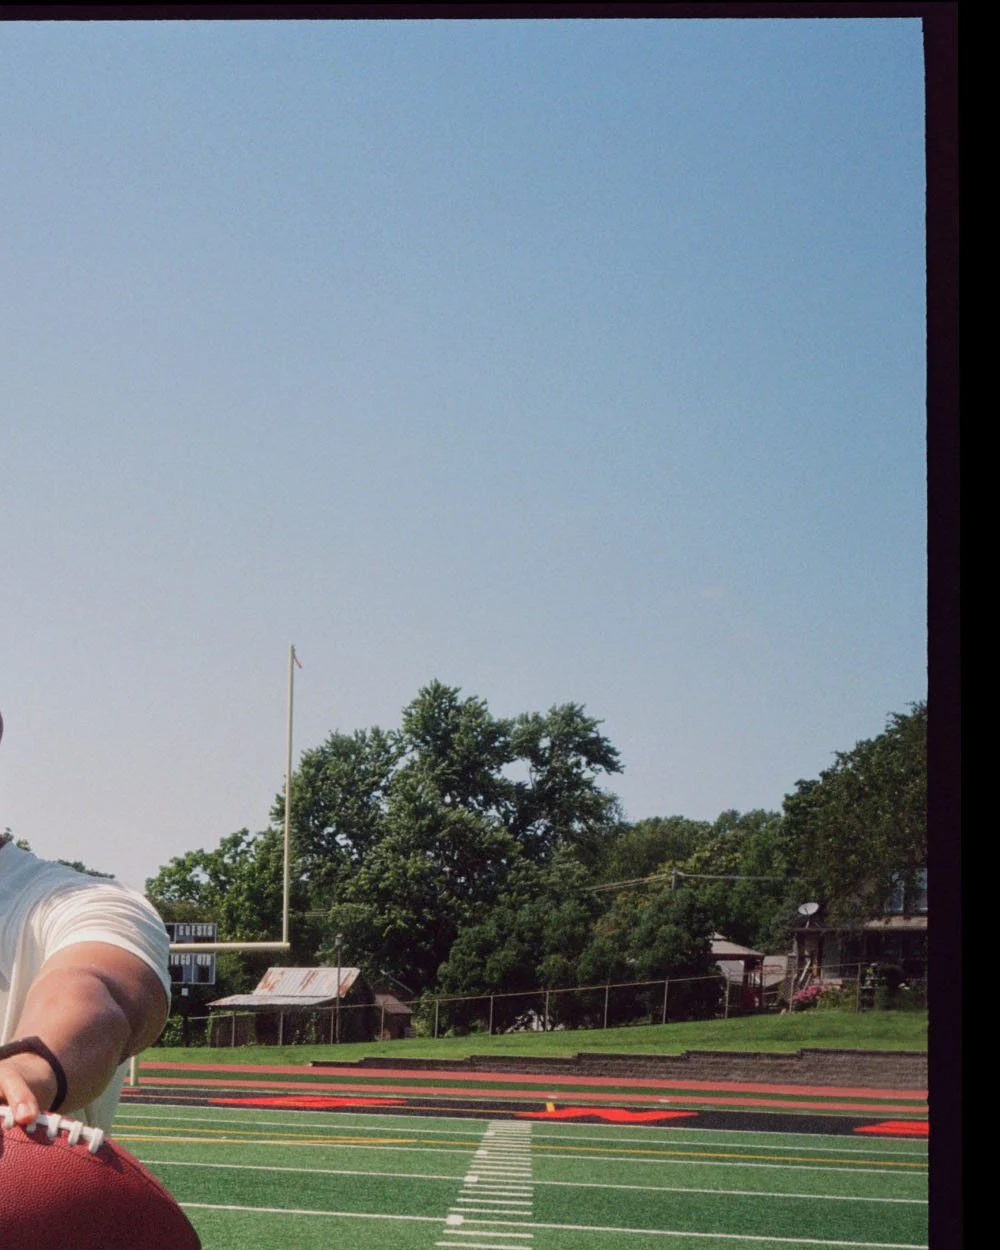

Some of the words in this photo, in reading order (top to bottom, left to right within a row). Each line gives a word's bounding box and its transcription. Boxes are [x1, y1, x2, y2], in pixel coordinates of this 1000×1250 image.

[179, 925, 213, 937] GUESTS
[170, 954, 180, 966] TO
[181, 954, 191, 966] GO
[196, 954, 211, 966] QTR
